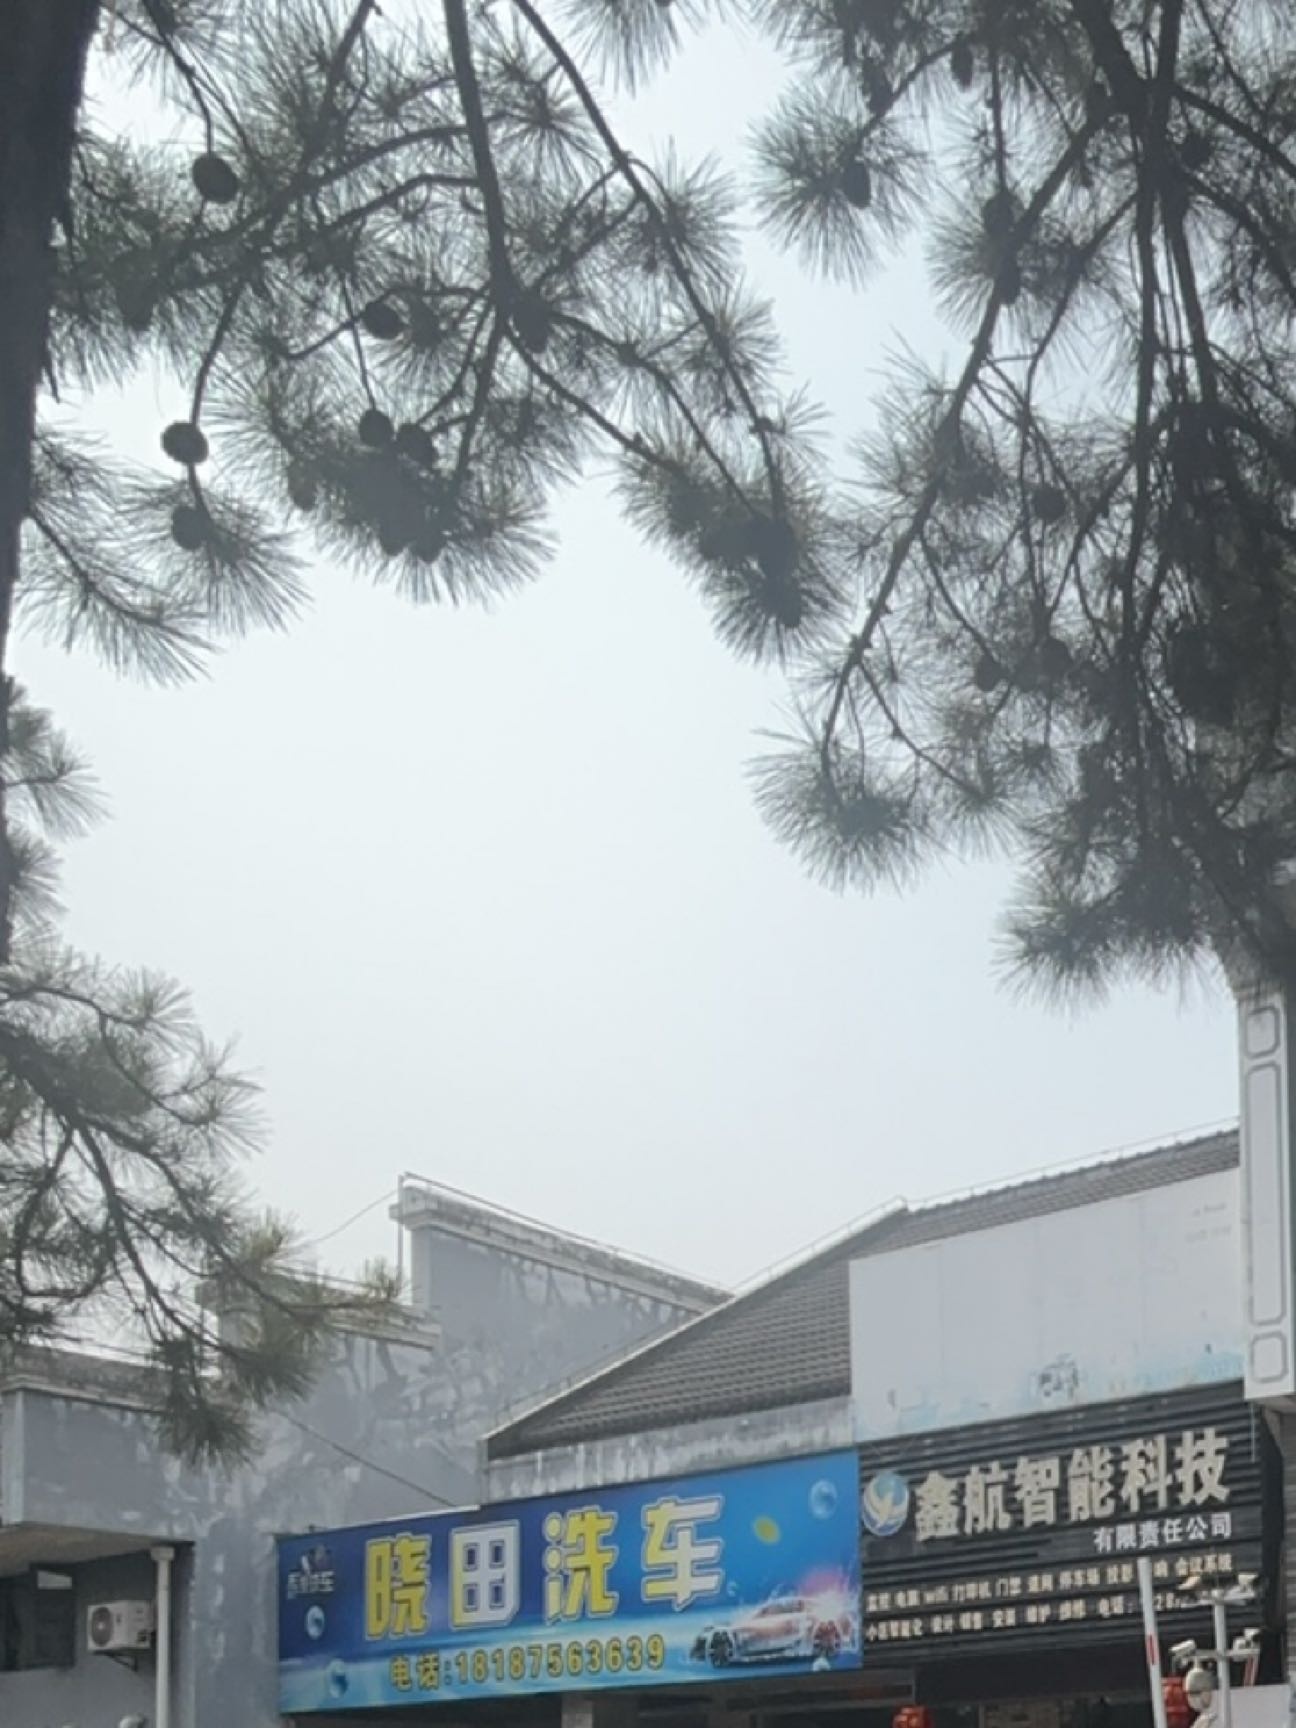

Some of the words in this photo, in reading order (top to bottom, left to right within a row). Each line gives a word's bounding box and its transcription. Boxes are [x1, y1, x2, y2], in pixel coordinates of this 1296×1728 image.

[914, 1427, 1231, 1542] 鑫航智能科技
[1094, 1512, 1232, 1553] 有限责任公司
[364, 1494, 724, 1641] 晓田洗车
